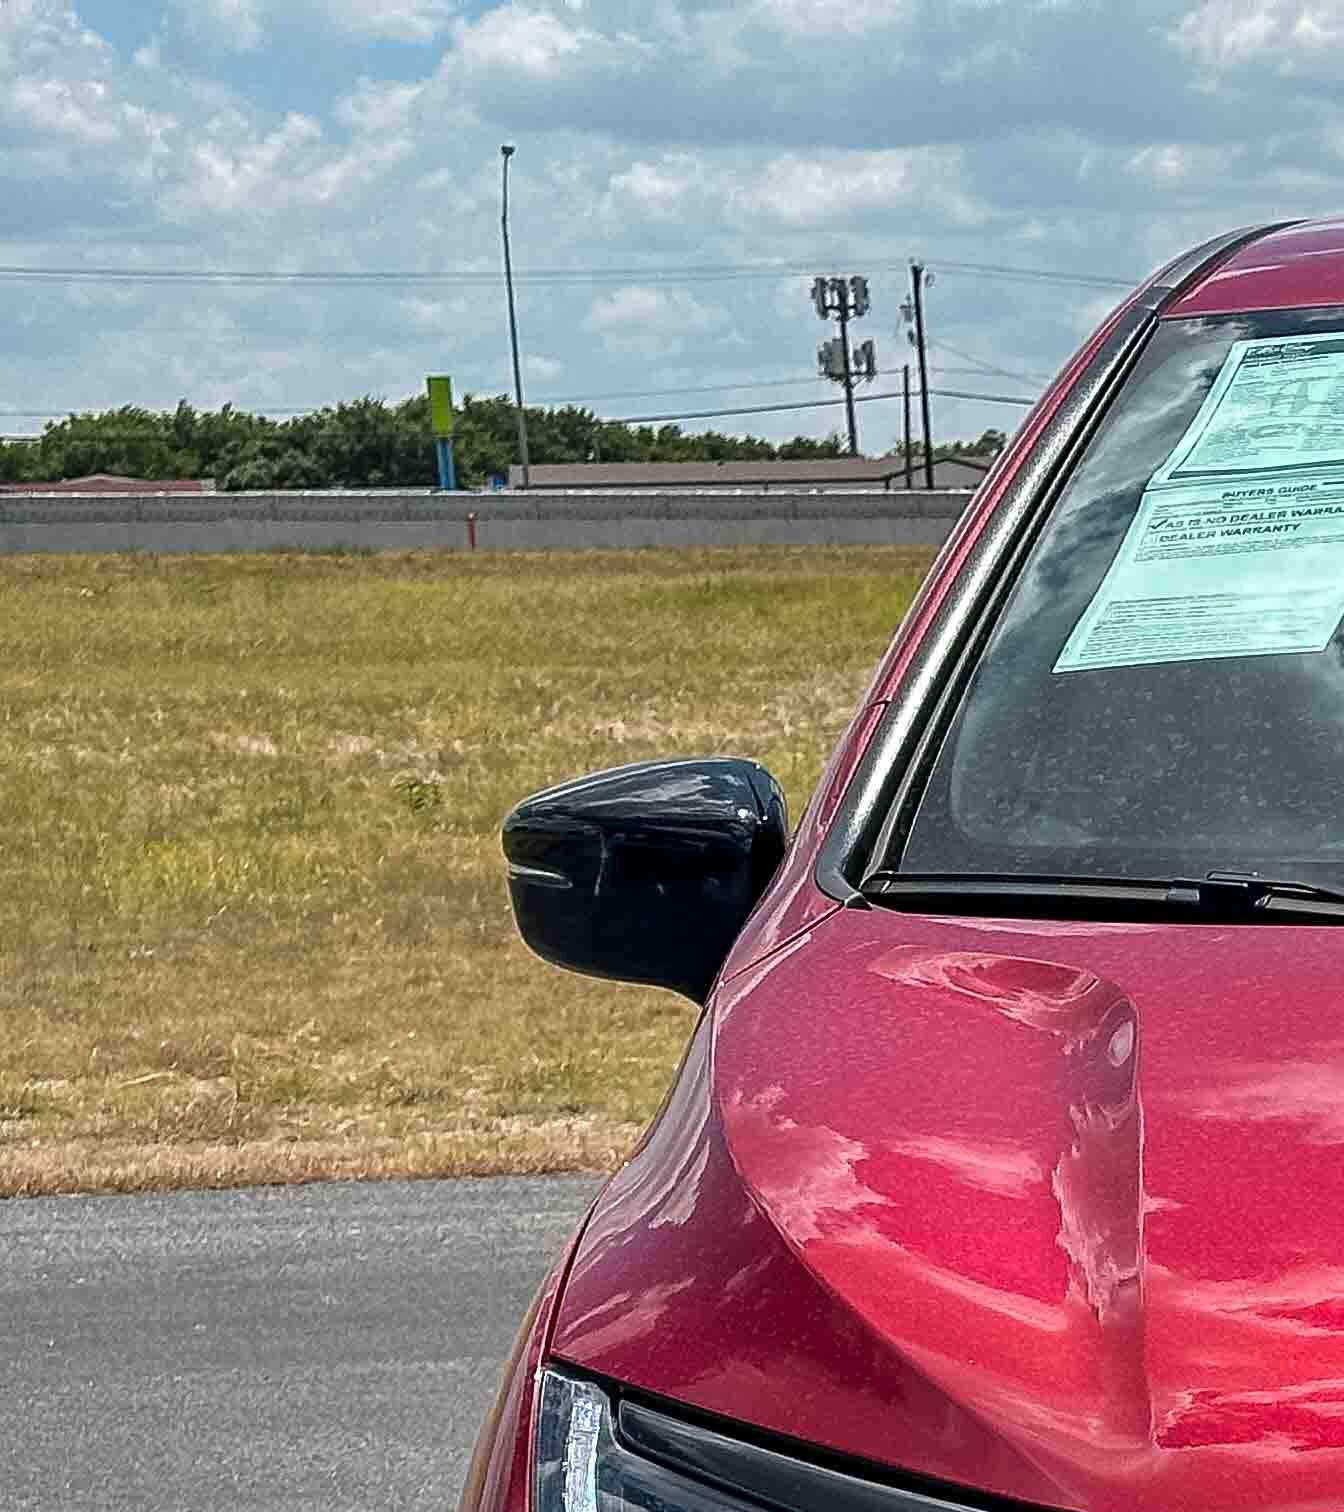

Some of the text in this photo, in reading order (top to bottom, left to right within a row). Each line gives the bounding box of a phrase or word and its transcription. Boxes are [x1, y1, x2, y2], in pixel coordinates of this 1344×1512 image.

[1278, 483, 1318, 494] GUIDE
[1165, 520, 1184, 529] AS
[1229, 510, 1287, 523] DEALER
[1159, 523, 1302, 543] DEALER WARRANTY
